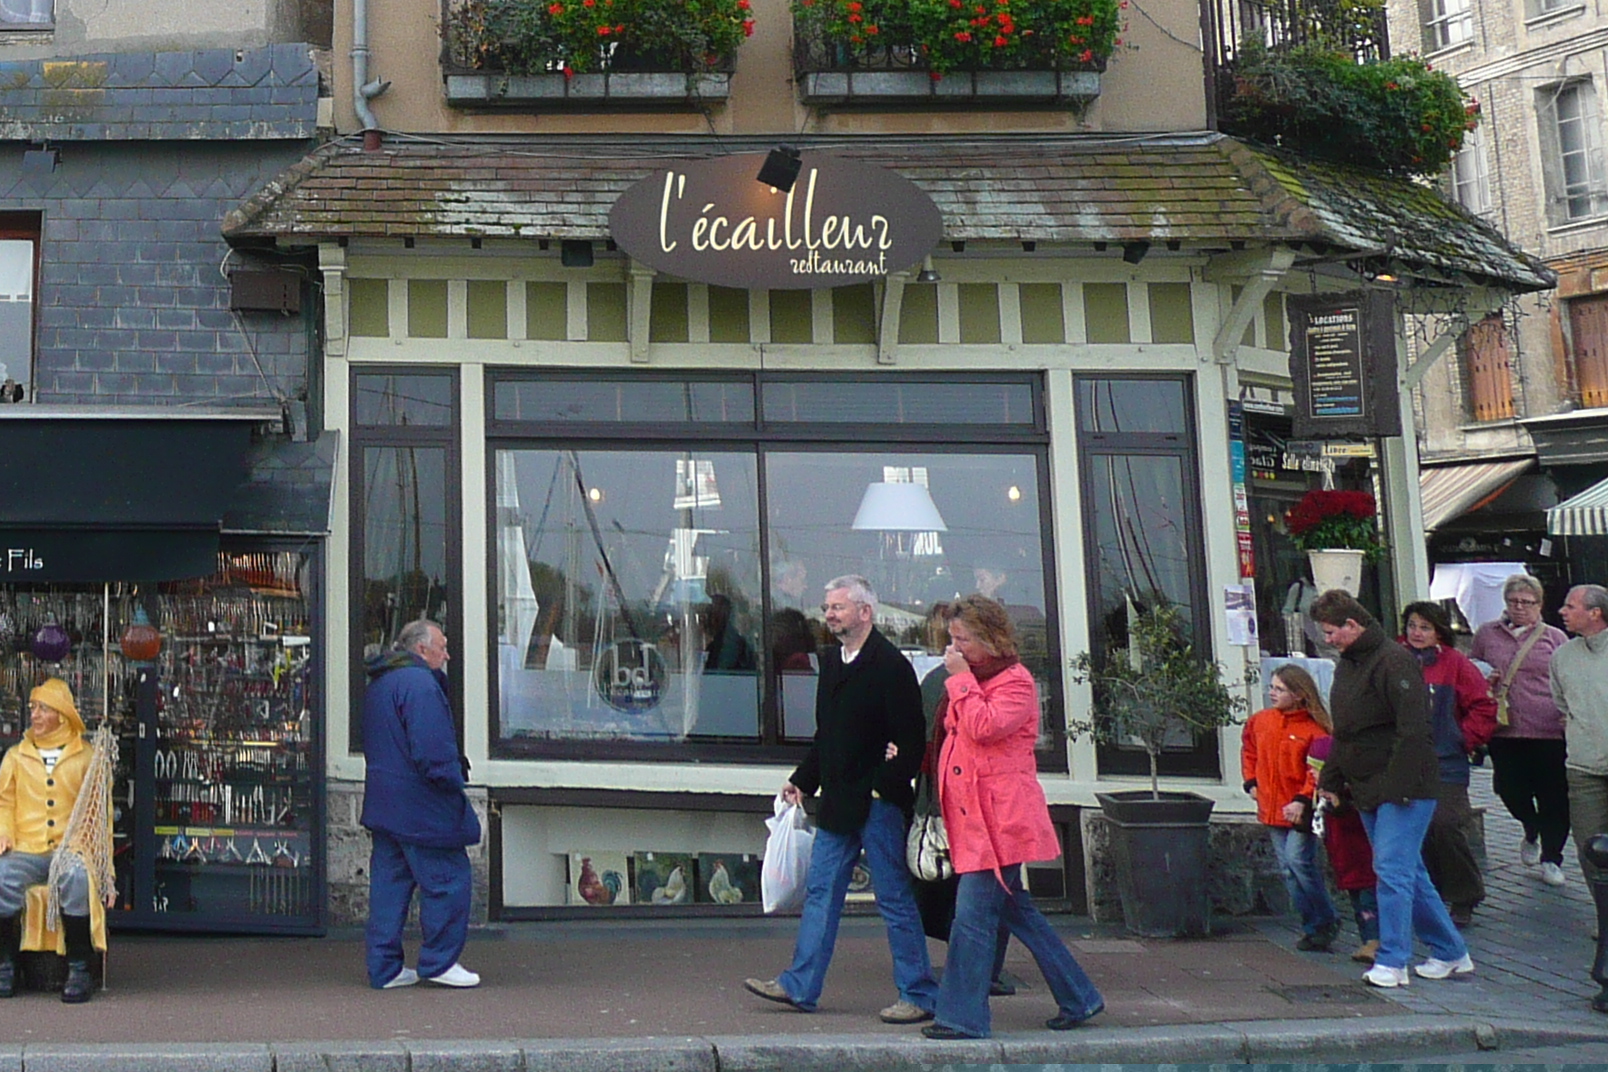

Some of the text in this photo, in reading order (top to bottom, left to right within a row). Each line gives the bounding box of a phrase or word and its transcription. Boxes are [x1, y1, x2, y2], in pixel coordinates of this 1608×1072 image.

[659, 168, 892, 253] l'écailleur
[790, 250, 889, 275] restaurant
[8, 548, 44, 572] Fils
